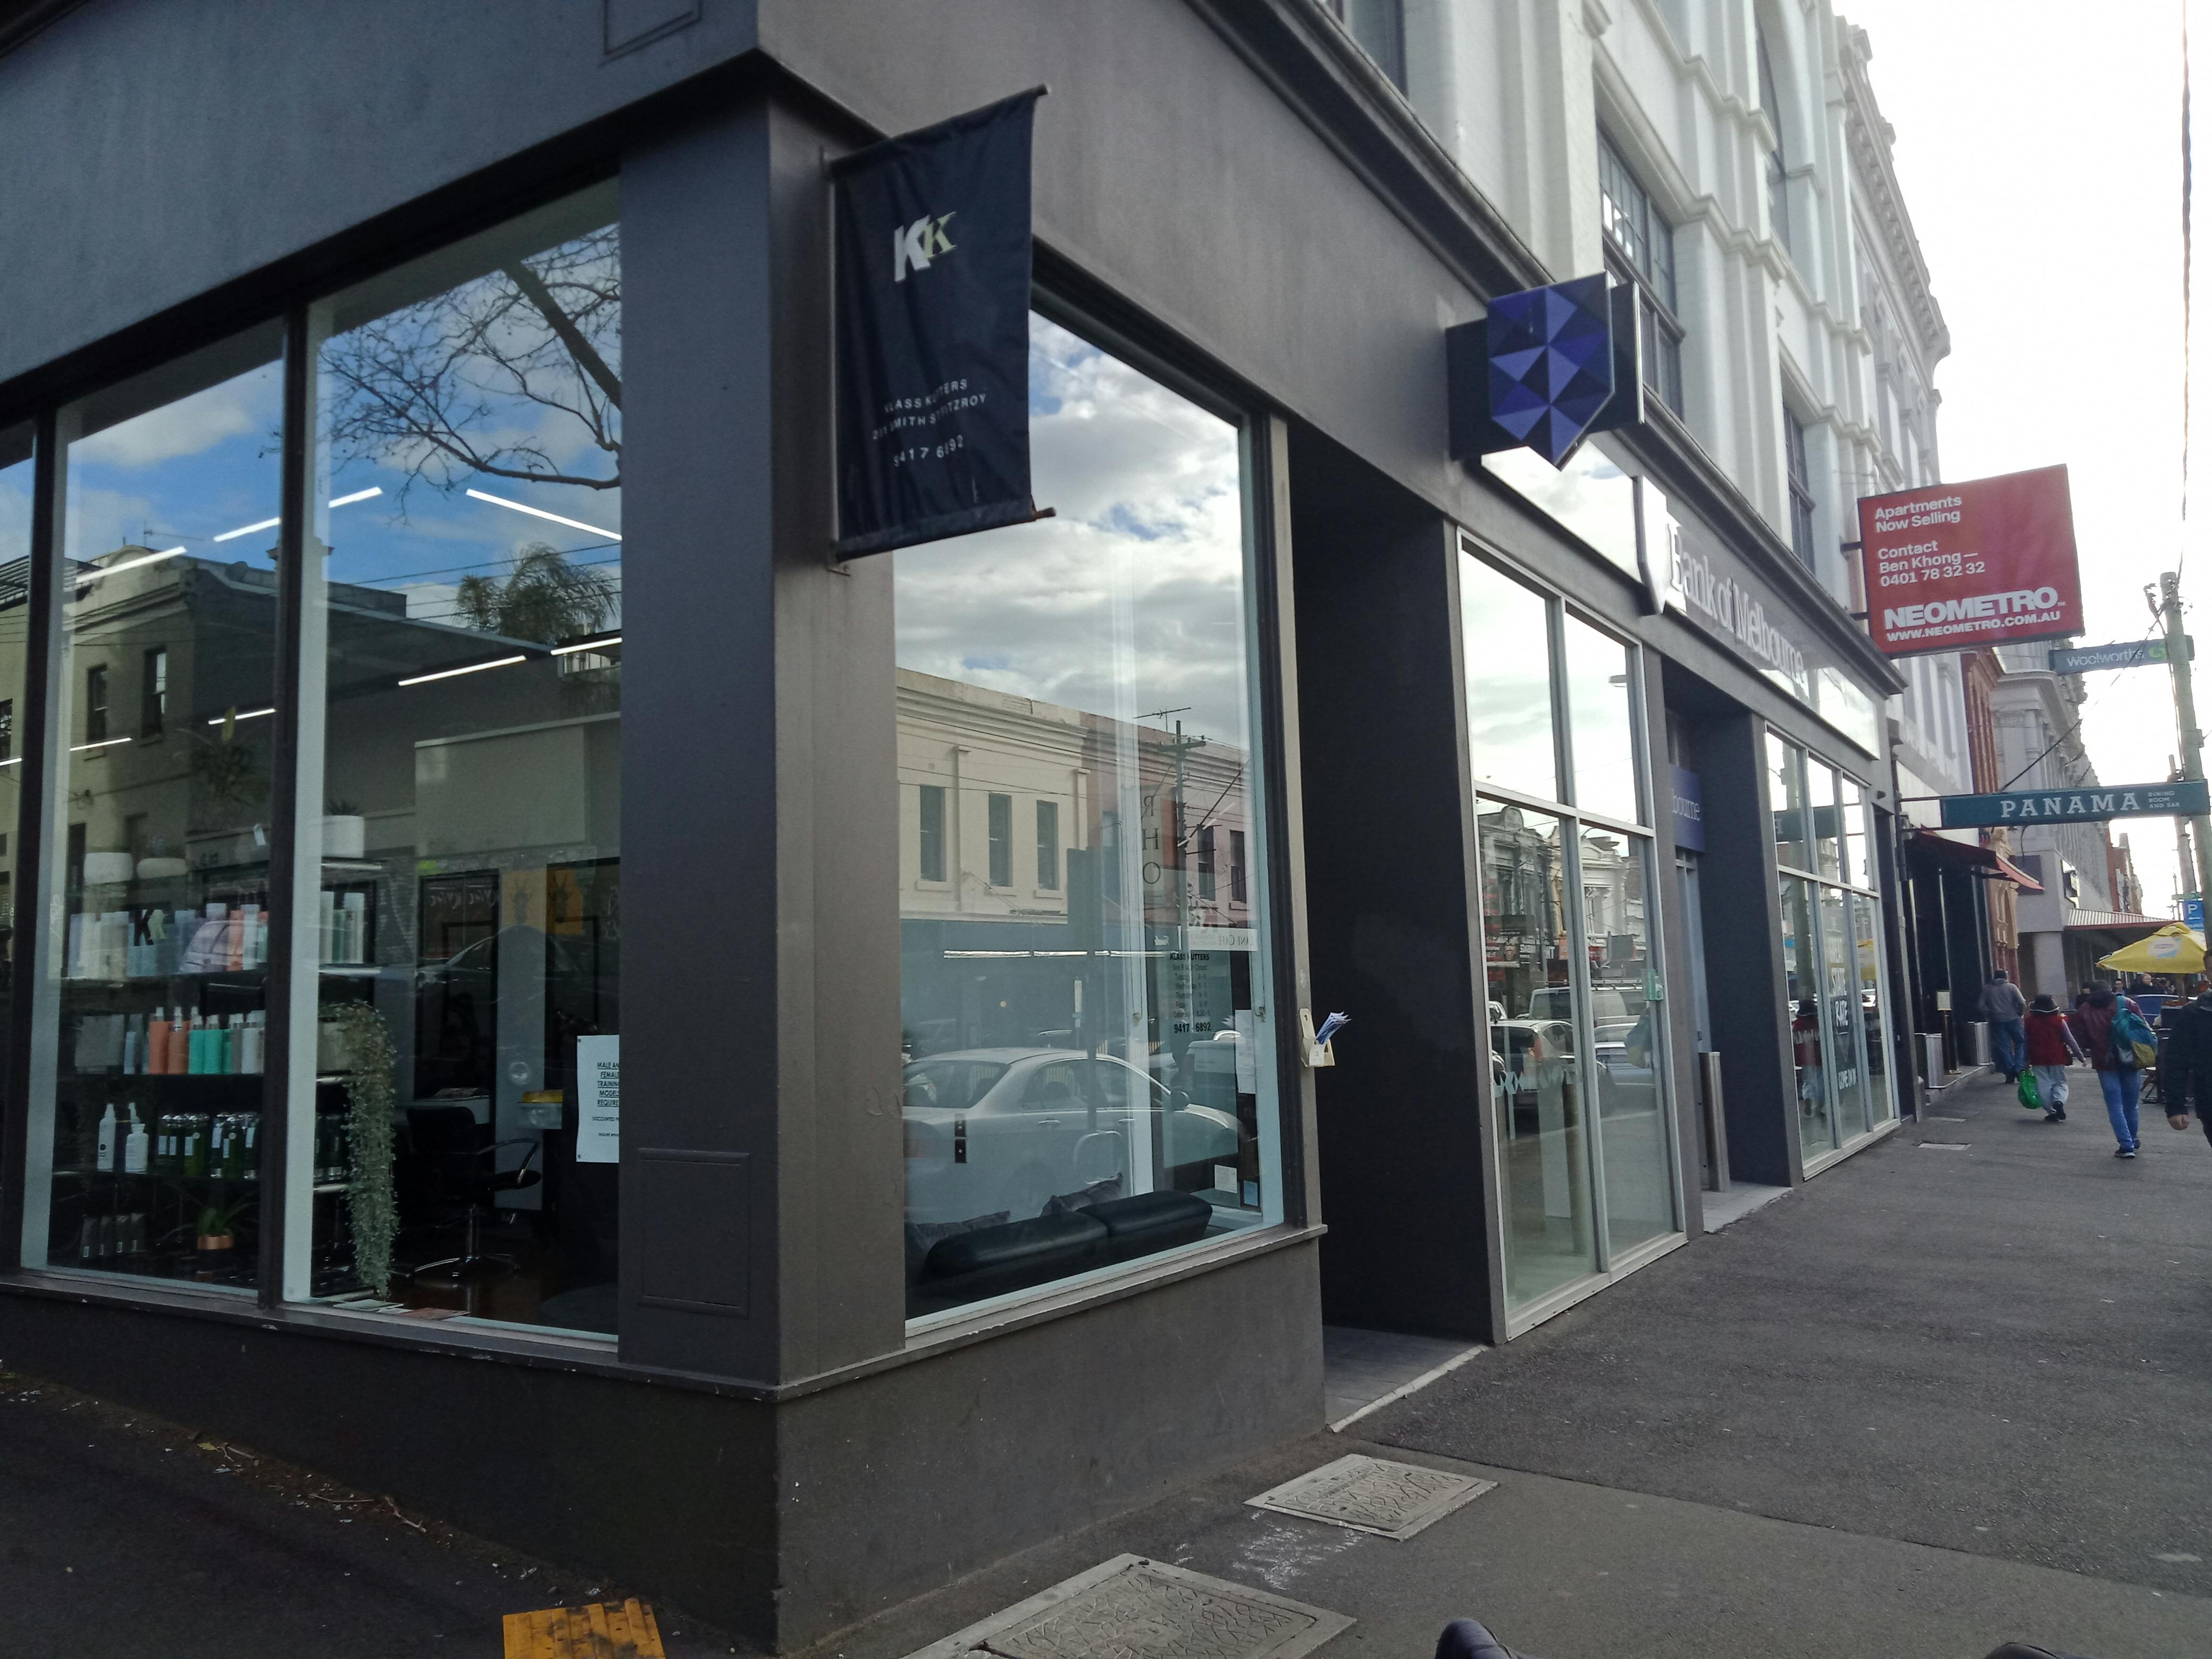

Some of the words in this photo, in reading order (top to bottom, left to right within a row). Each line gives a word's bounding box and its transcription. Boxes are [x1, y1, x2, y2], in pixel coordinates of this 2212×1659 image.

[1875, 496, 1962, 520] Apartments
[1876, 519, 1909, 533] Now
[1912, 510, 1960, 527] Selling
[1878, 540, 1939, 560] Contact
[1879, 561, 1908, 574] Ben
[1912, 552, 1962, 569] Khong
[1880, 571, 1918, 587] 0401
[1921, 567, 1940, 581] 78
[1943, 565, 1963, 578] 32
[1965, 561, 1985, 575] 32
[1883, 586, 2058, 630] NEOMETRO
[1887, 610, 2061, 642] WWW.NEOMETRO.COM.AU
[2067, 648, 2144, 667] woolworths
[2000, 792, 2141, 818] PANAMA
[2187, 903, 2198, 915] P
[1174, 1023, 1190, 1034] 9417
[1196, 1021, 1212, 1032] 6892
